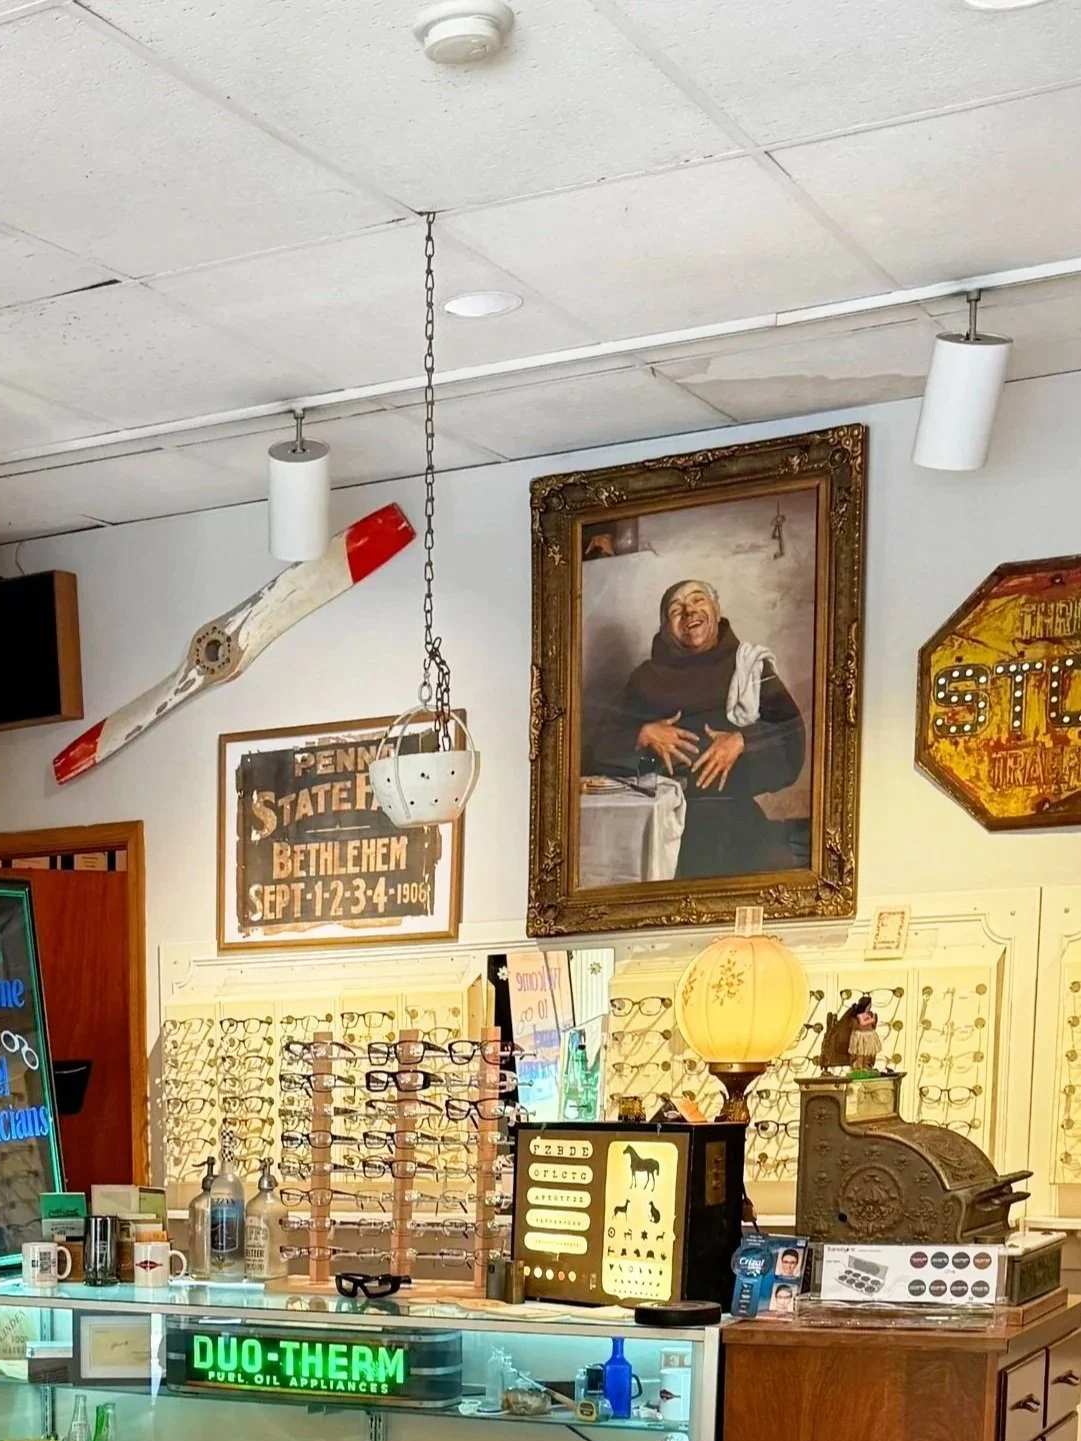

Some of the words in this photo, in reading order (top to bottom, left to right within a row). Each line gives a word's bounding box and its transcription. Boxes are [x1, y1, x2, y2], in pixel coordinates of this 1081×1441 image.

[1020, 599, 1081, 639] THR
[251, 780, 352, 841] STATE
[273, 835, 408, 879] BETHLEHEM
[193, 1335, 405, 1384] DUO-THERM
[254, 1374, 281, 1387] OIL
[288, 1376, 389, 1394] APPLIANCES
